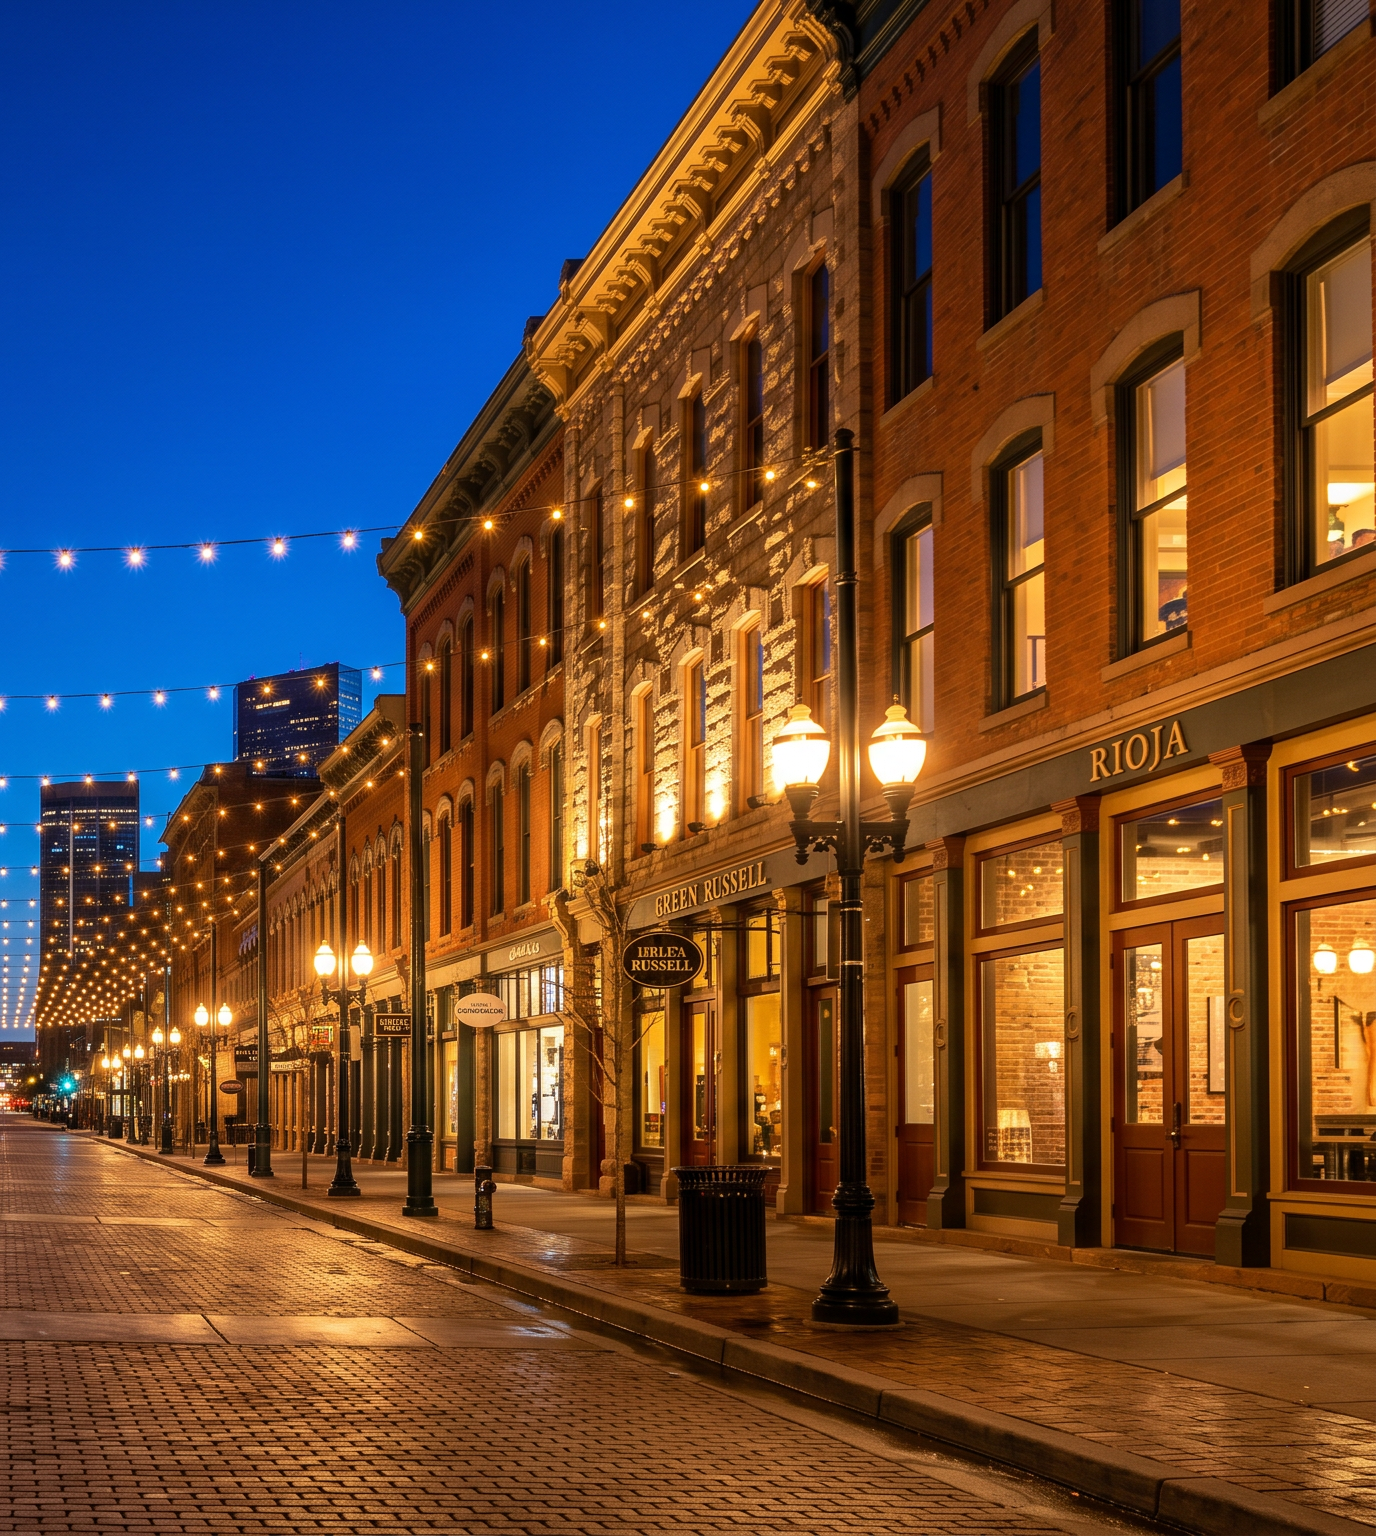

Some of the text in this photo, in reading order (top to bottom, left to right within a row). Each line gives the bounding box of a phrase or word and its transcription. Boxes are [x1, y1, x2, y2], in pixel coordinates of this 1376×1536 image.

[1090, 720, 1189, 782] RIOJA
[655, 861, 767, 918] GREEN RUSSELL
[631, 960, 693, 971] RUSSELL
